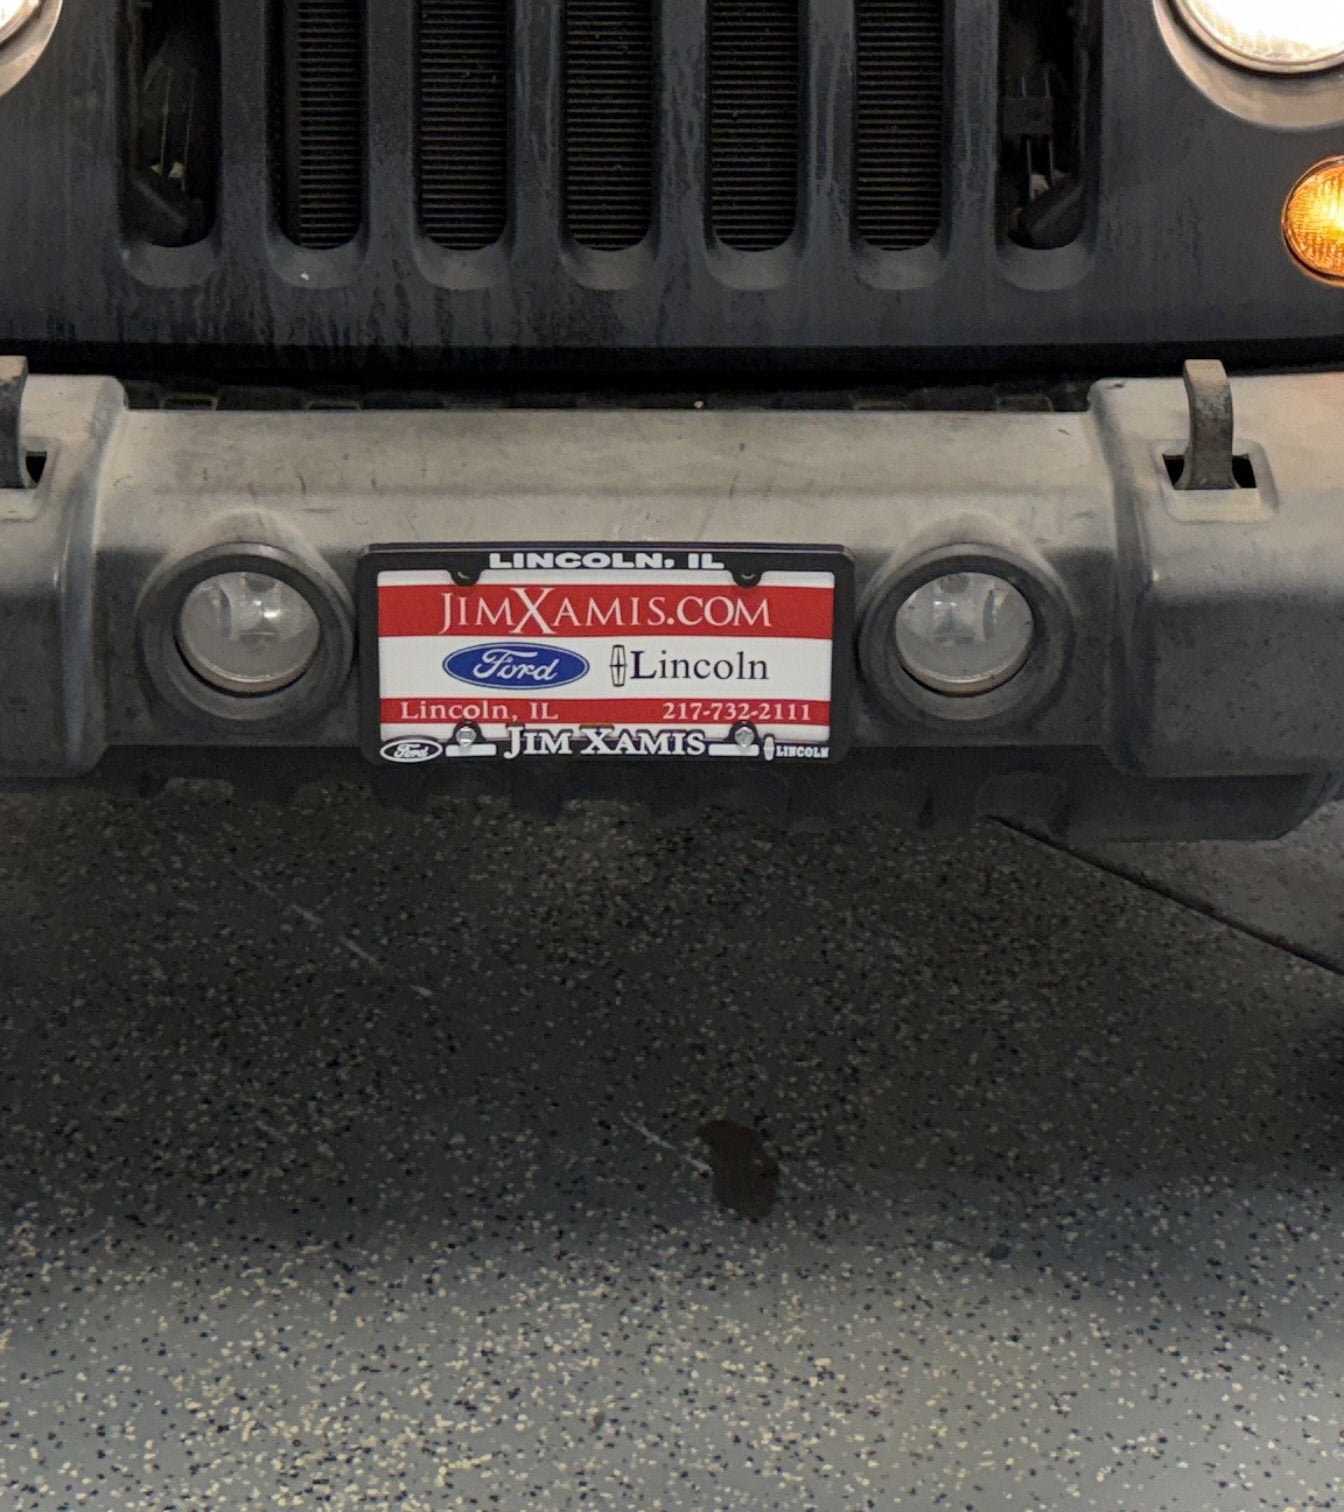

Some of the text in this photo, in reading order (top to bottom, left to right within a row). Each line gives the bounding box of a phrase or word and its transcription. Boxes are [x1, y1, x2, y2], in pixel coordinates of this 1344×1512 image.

[489, 553, 725, 569] LINCOLN, IL
[473, 648, 559, 681] Ford
[629, 650, 769, 680] Lincoln
[400, 700, 559, 721] Lincoln, IL
[662, 701, 811, 721] 217-732-2111
[393, 744, 429, 760] Ford
[503, 726, 706, 759] JIM XAMIS
[776, 746, 829, 759] LINCOLN
